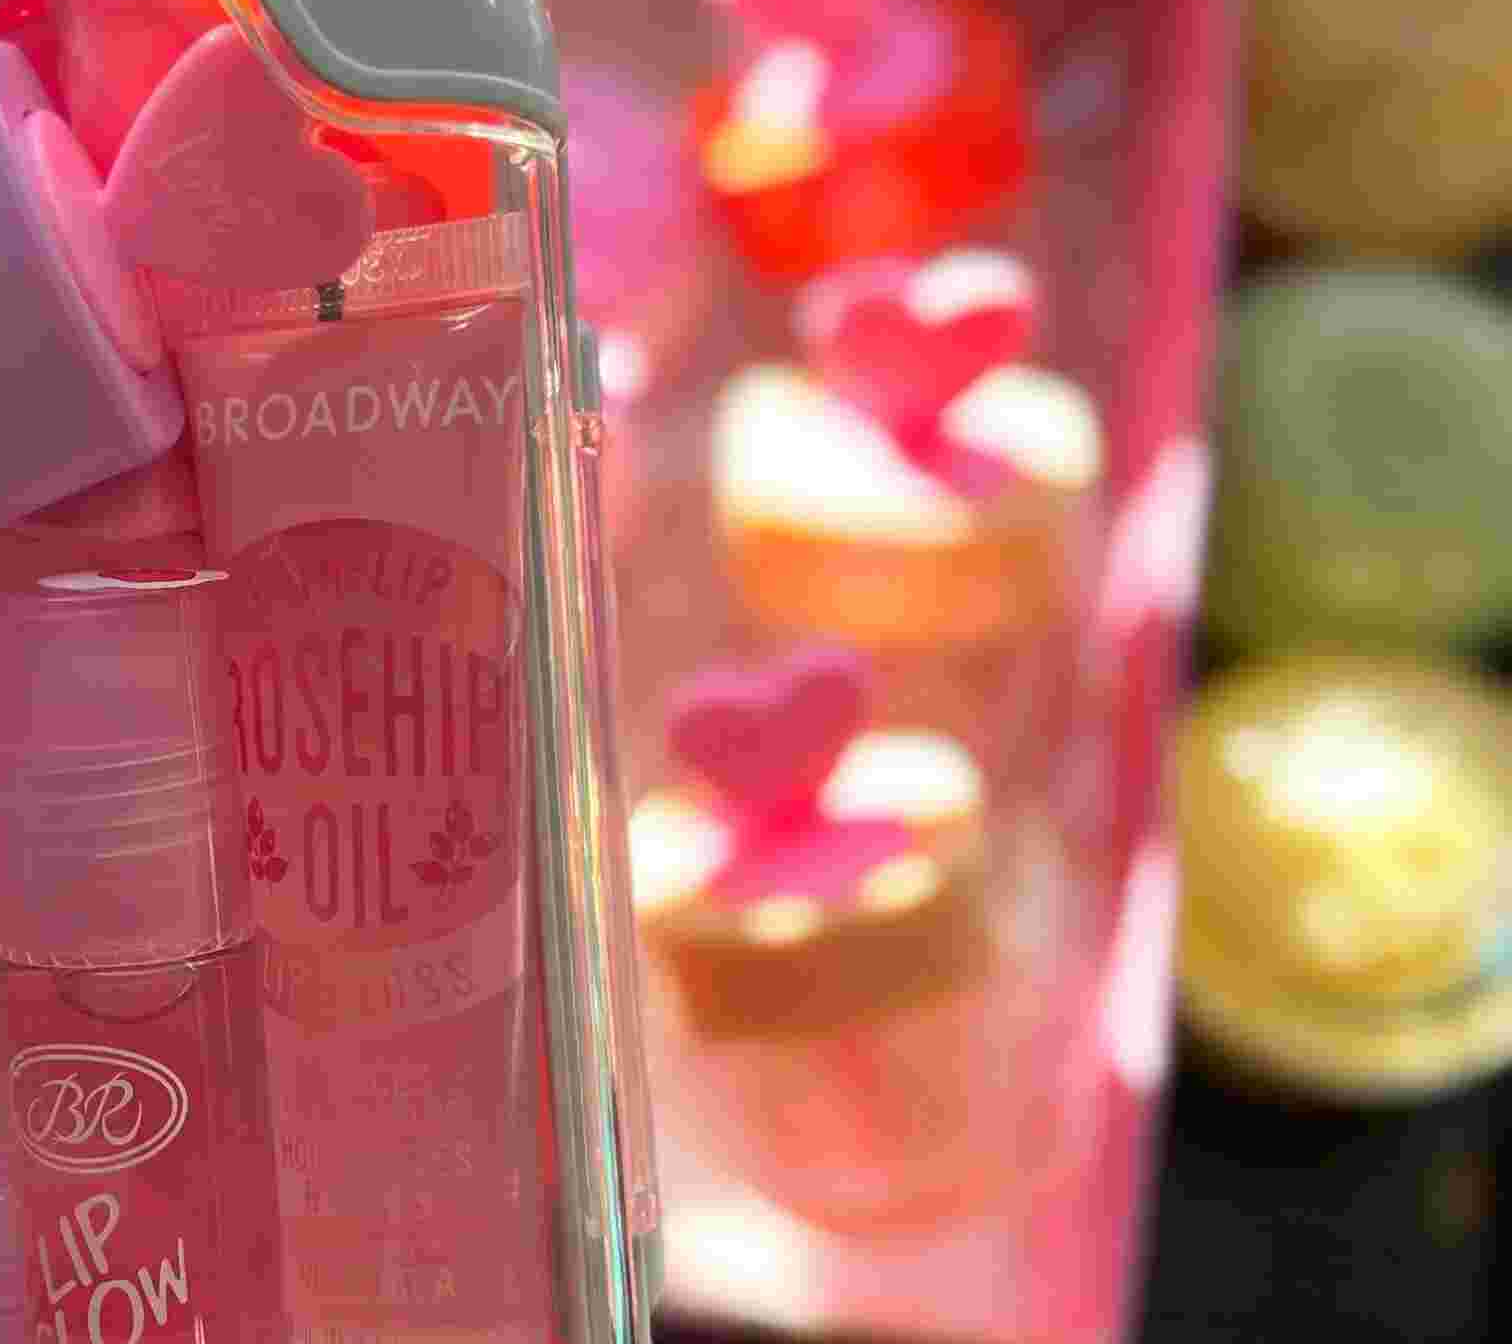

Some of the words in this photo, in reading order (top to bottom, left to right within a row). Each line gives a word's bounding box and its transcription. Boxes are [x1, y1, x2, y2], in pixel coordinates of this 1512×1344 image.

[194, 374, 519, 448] BROADWAY
[302, 801, 410, 928] OIL
[38, 1192, 121, 1305] LIP
